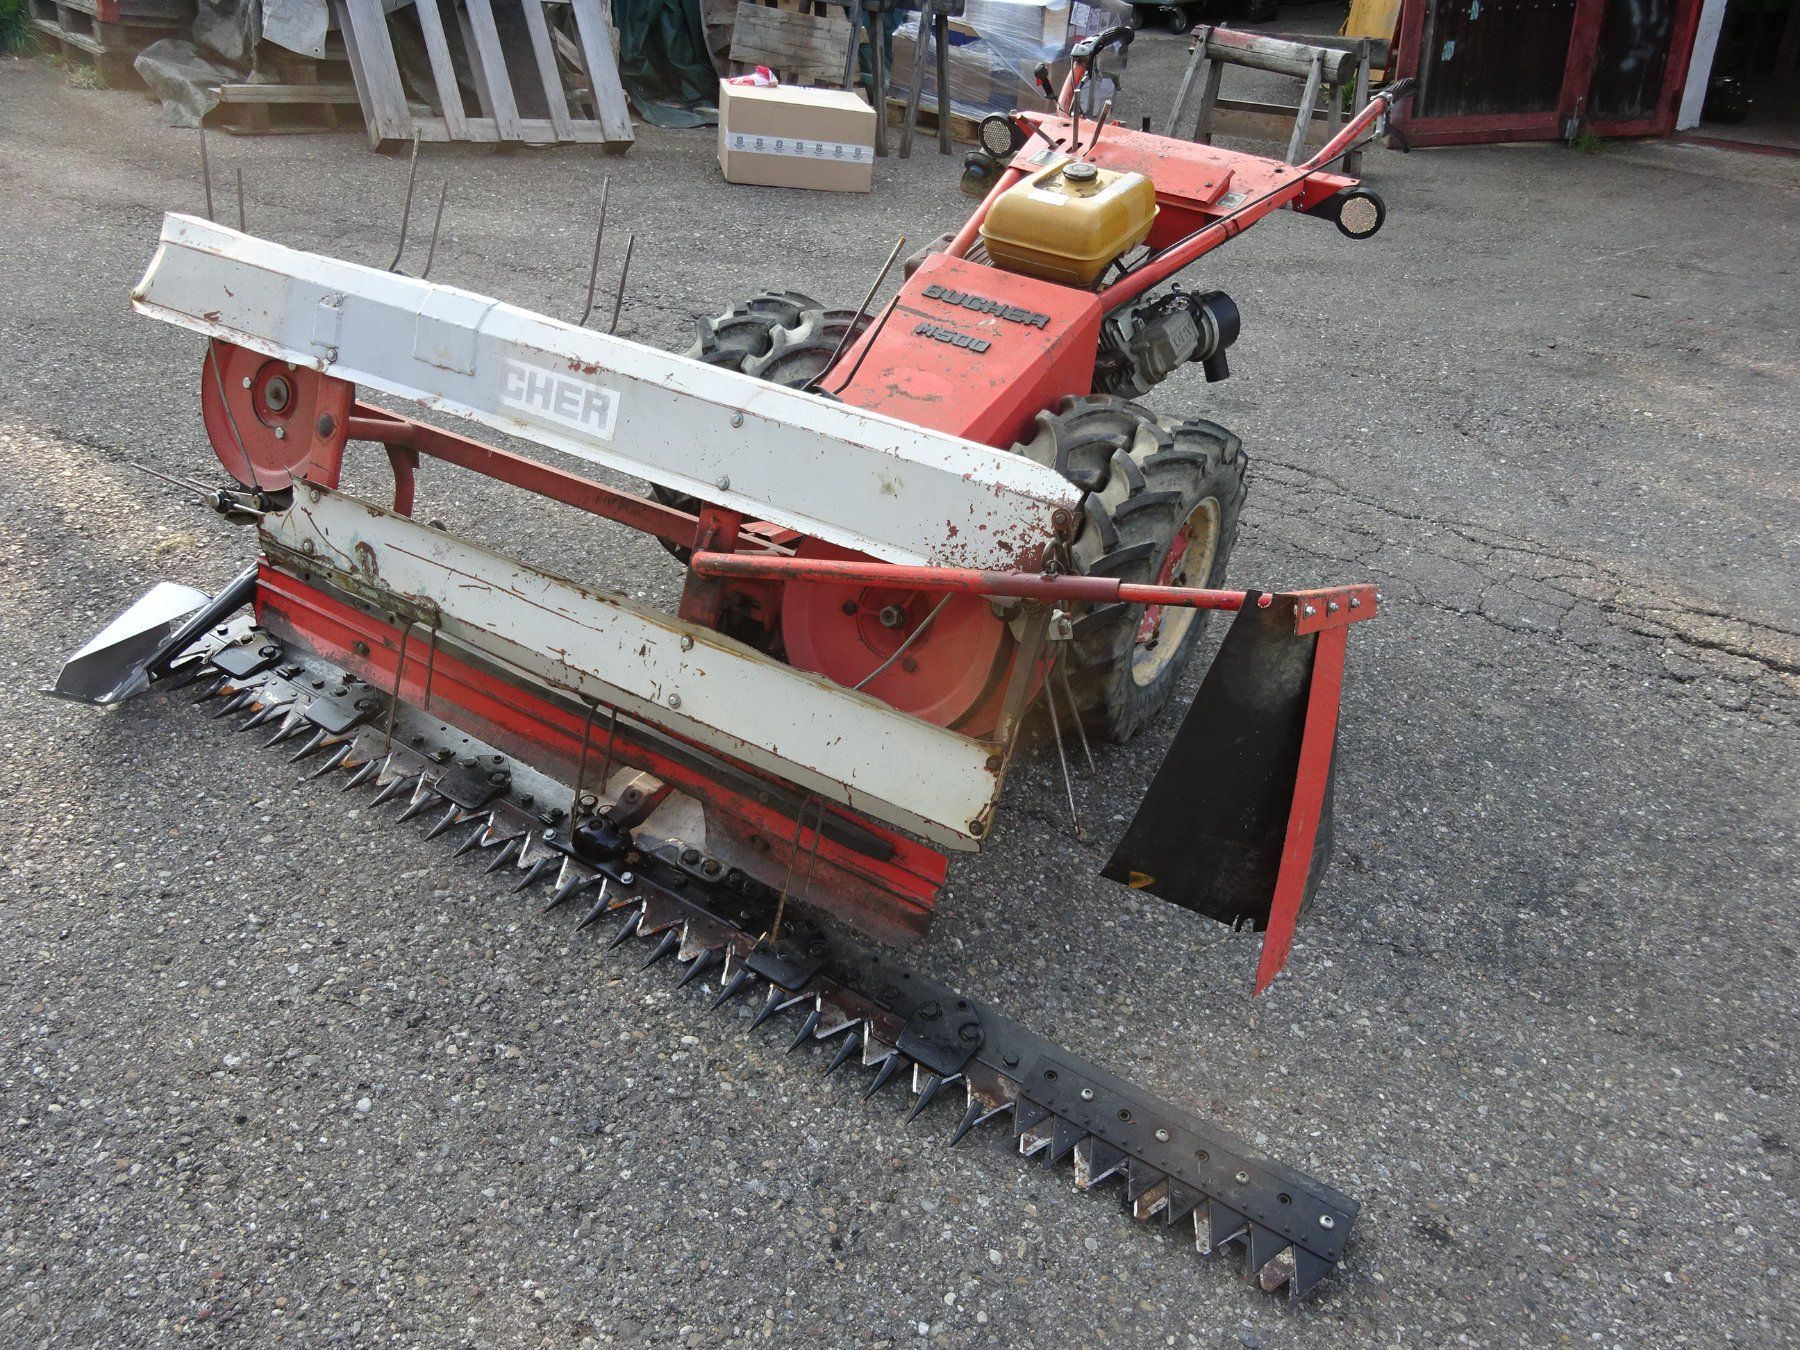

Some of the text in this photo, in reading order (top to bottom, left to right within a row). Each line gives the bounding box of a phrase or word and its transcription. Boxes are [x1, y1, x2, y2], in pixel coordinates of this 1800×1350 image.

[921, 284, 1050, 330] BUCHER
[915, 322, 991, 353] M500
[500, 362, 611, 430] CHER
